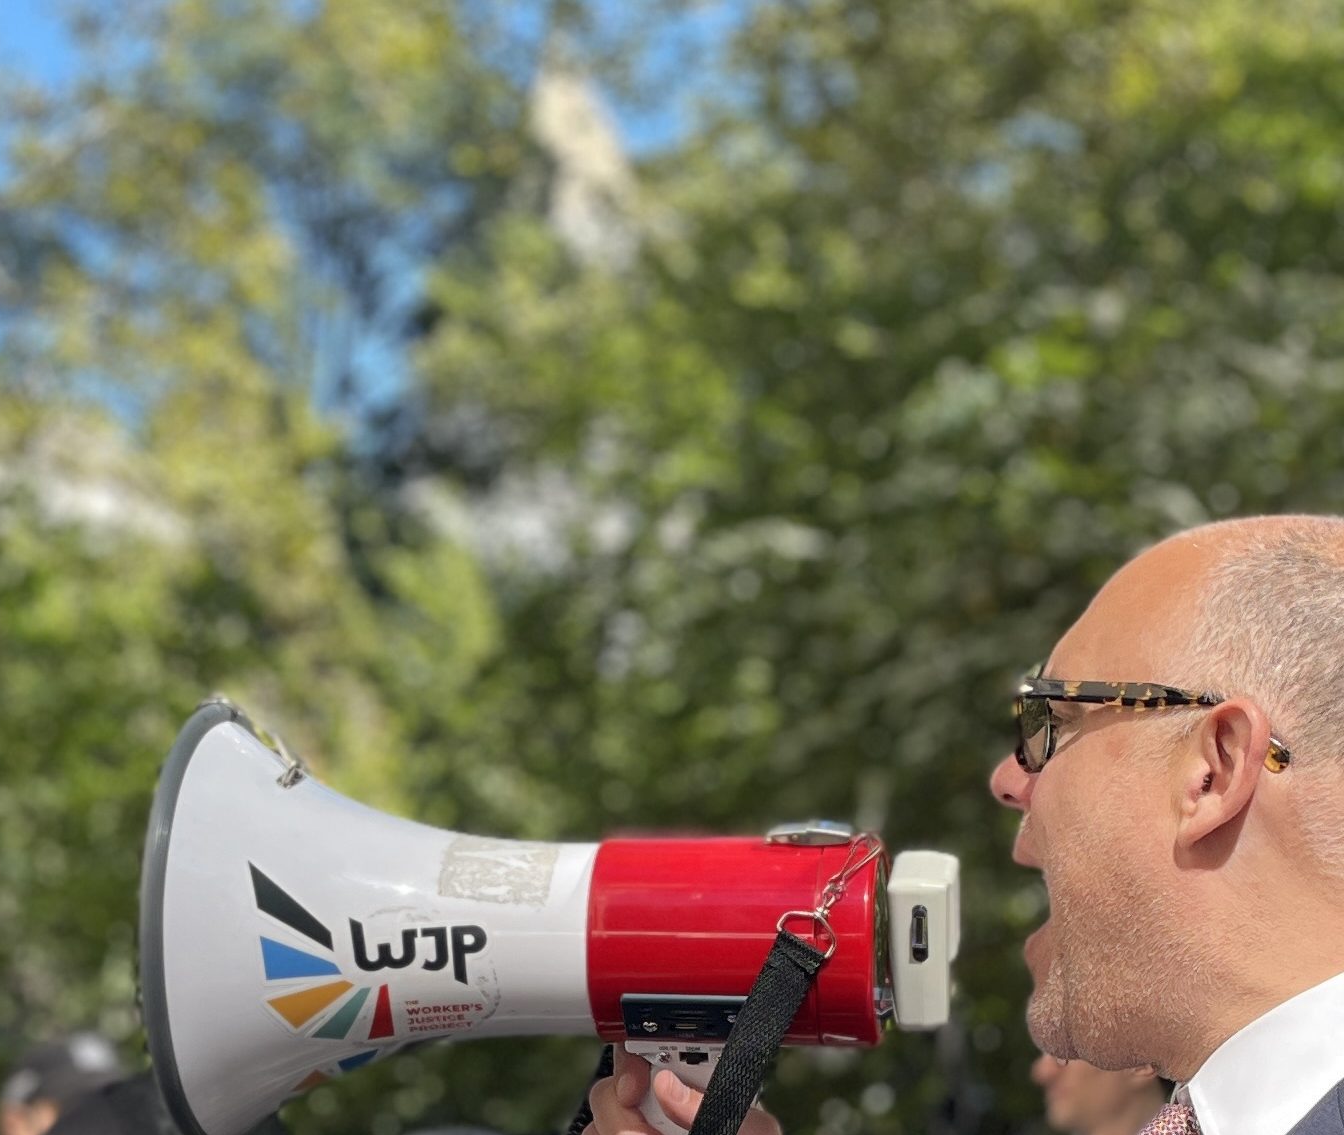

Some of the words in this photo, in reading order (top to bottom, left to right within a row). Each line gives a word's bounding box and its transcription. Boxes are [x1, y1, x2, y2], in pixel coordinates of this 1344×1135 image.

[349, 917, 487, 985] WJP
[406, 1004, 483, 1015] WORKER'S
[408, 1014, 465, 1025] JUSTICE
[409, 1021, 472, 1032] PROJECT
